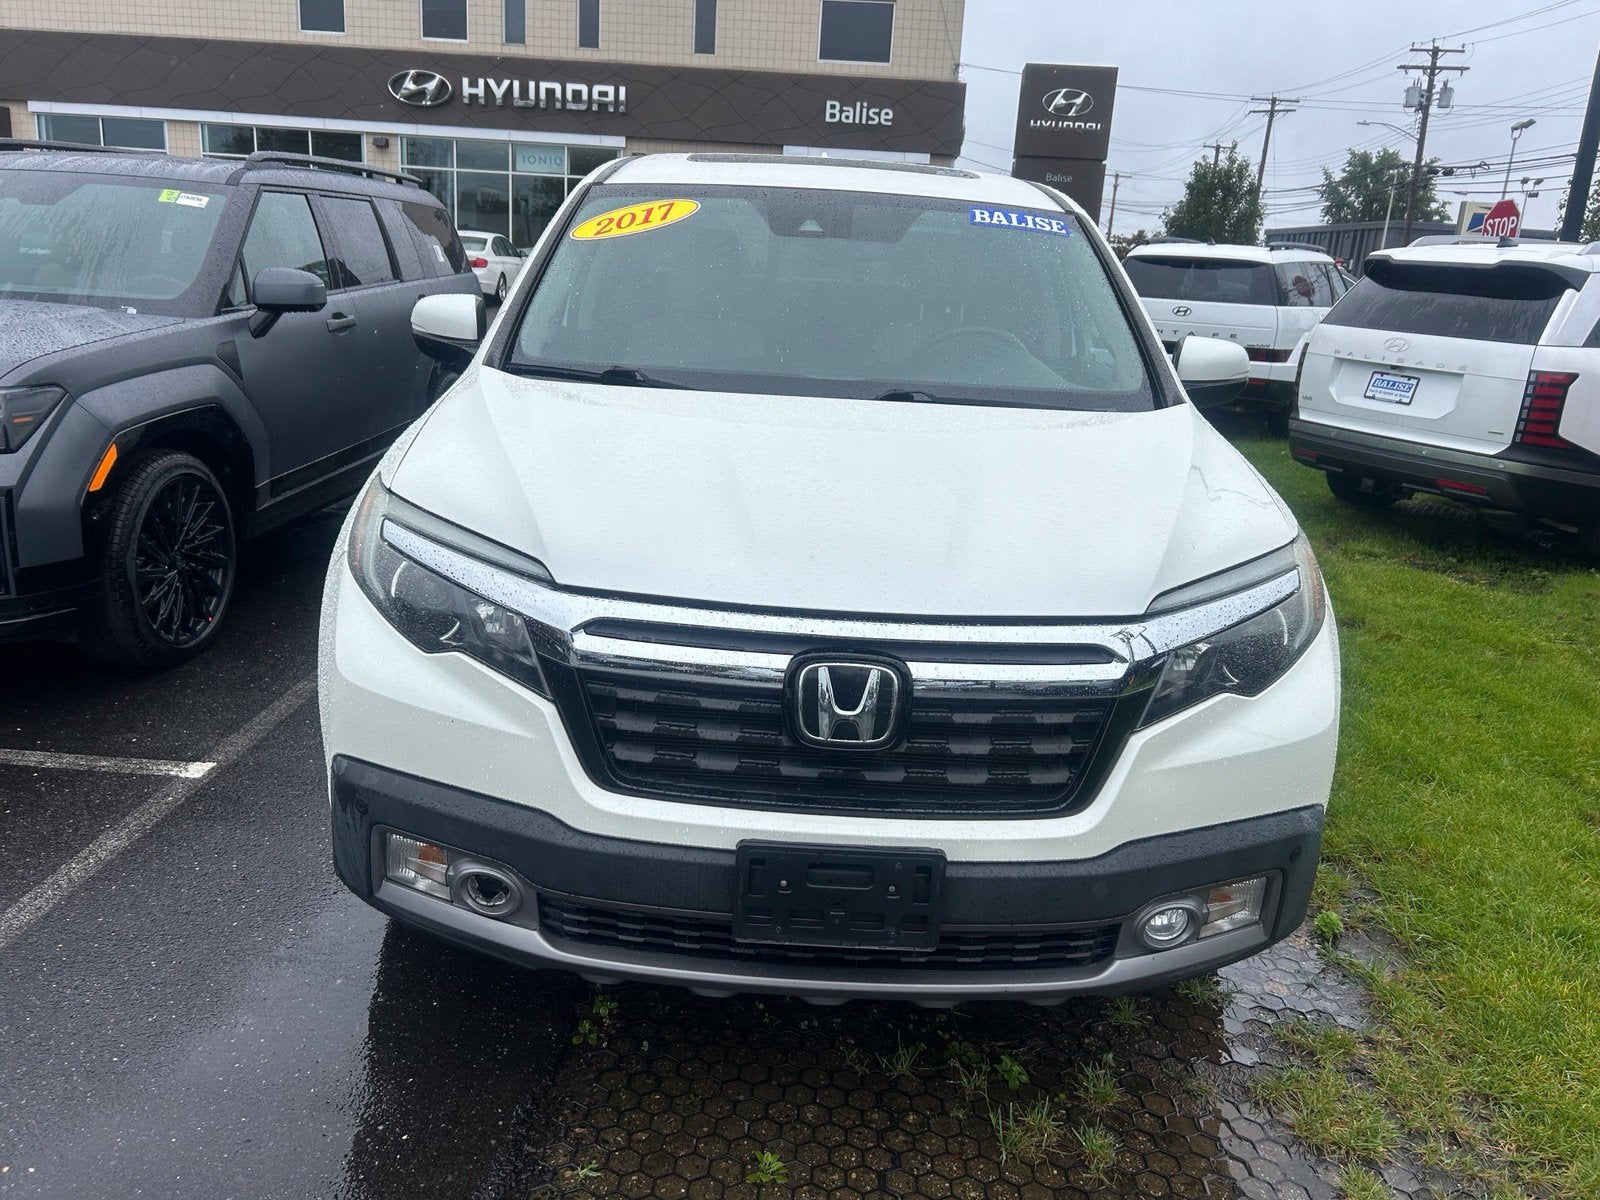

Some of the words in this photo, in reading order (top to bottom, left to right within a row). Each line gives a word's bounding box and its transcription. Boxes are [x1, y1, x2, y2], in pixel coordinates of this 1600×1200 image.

[462, 77, 626, 113] HYUNDAI
[825, 100, 893, 126] Balise
[1045, 172, 1073, 183] Balise
[593, 202, 676, 236] 2017
[972, 209, 1067, 234] BALISE
[1484, 215, 1517, 237] STOP
[1157, 329, 1197, 337] NTA
[1334, 349, 1468, 372] PALISADE
[1374, 379, 1412, 392] BALISE
